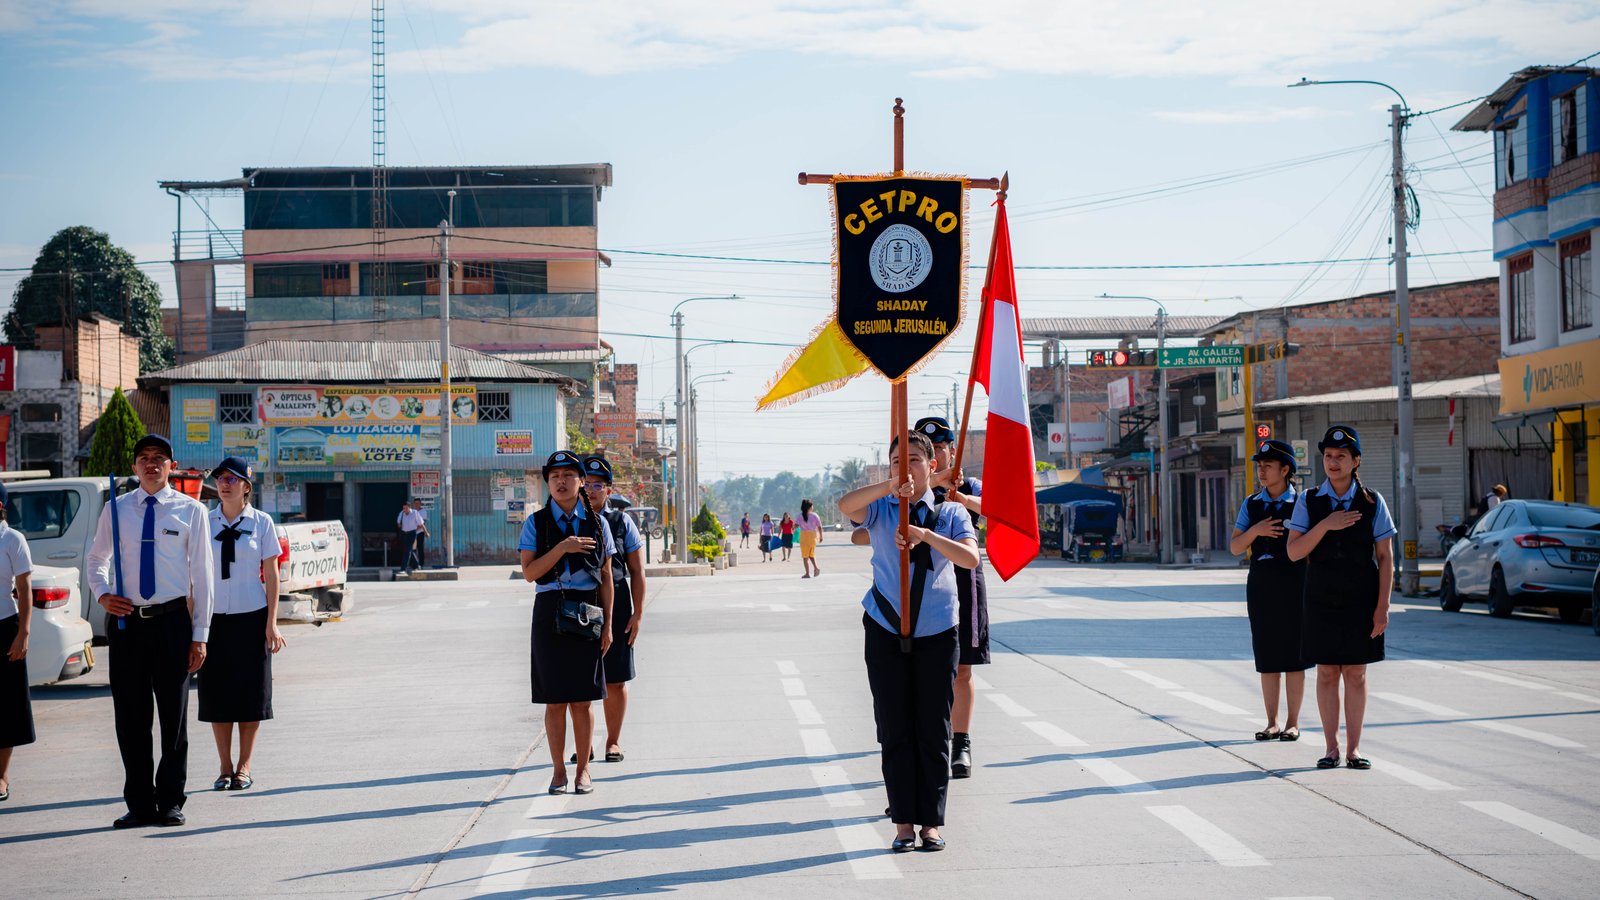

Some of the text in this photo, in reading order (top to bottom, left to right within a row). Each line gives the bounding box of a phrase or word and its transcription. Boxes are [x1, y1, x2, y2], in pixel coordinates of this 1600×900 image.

[844, 189, 958, 236] CETPRO
[881, 278, 915, 290] SHADAY
[876, 300, 929, 312] SHADAY
[853, 317, 947, 335] SEGUNDA JERUSALÉN
[1187, 348, 1241, 357] AV. GALILEA
[1173, 357, 1242, 366] JR. SAN MARTIN
[280, 392, 312, 401] ÓPTICAS
[274, 402, 316, 410] MAIALENTS
[357, 434, 418, 447] SINAMAL
[365, 452, 414, 461] LOTES
[301, 556, 337, 578] TOYOTA
